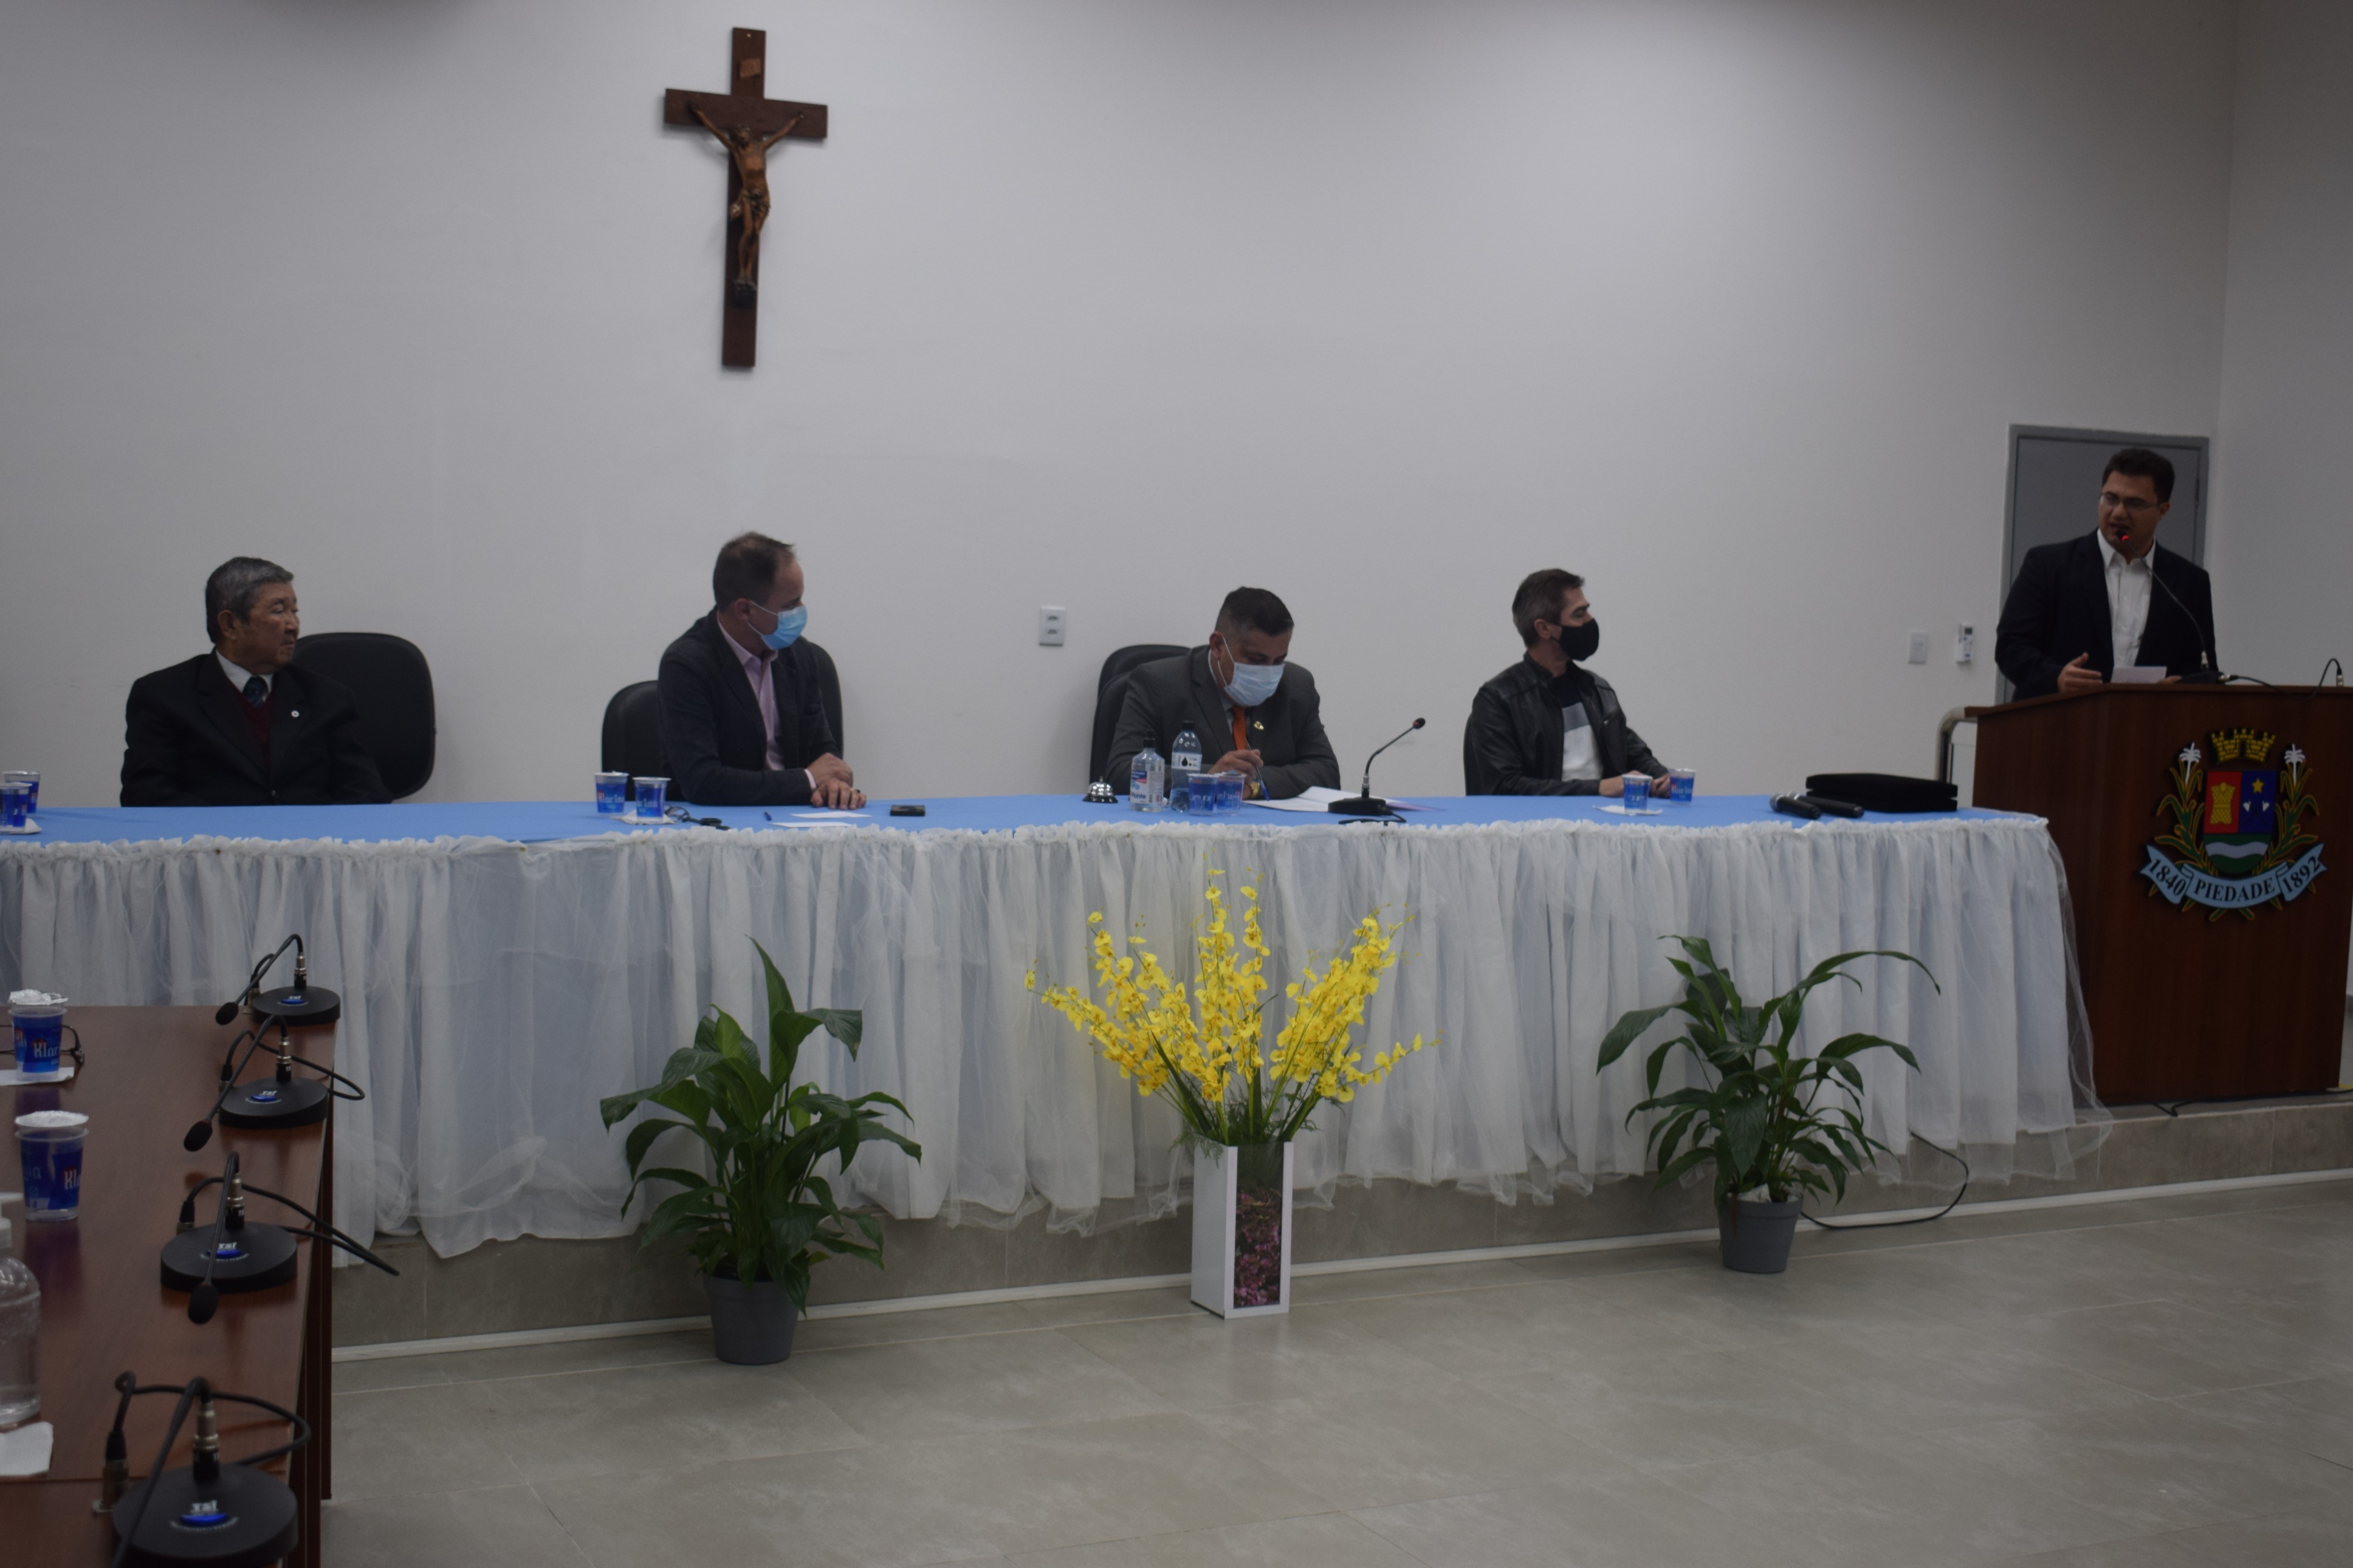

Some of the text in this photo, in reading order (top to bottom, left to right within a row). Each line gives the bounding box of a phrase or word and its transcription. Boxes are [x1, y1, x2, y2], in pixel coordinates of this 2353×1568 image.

[2148, 856, 2321, 902] 1840 PIEDADE 1892
